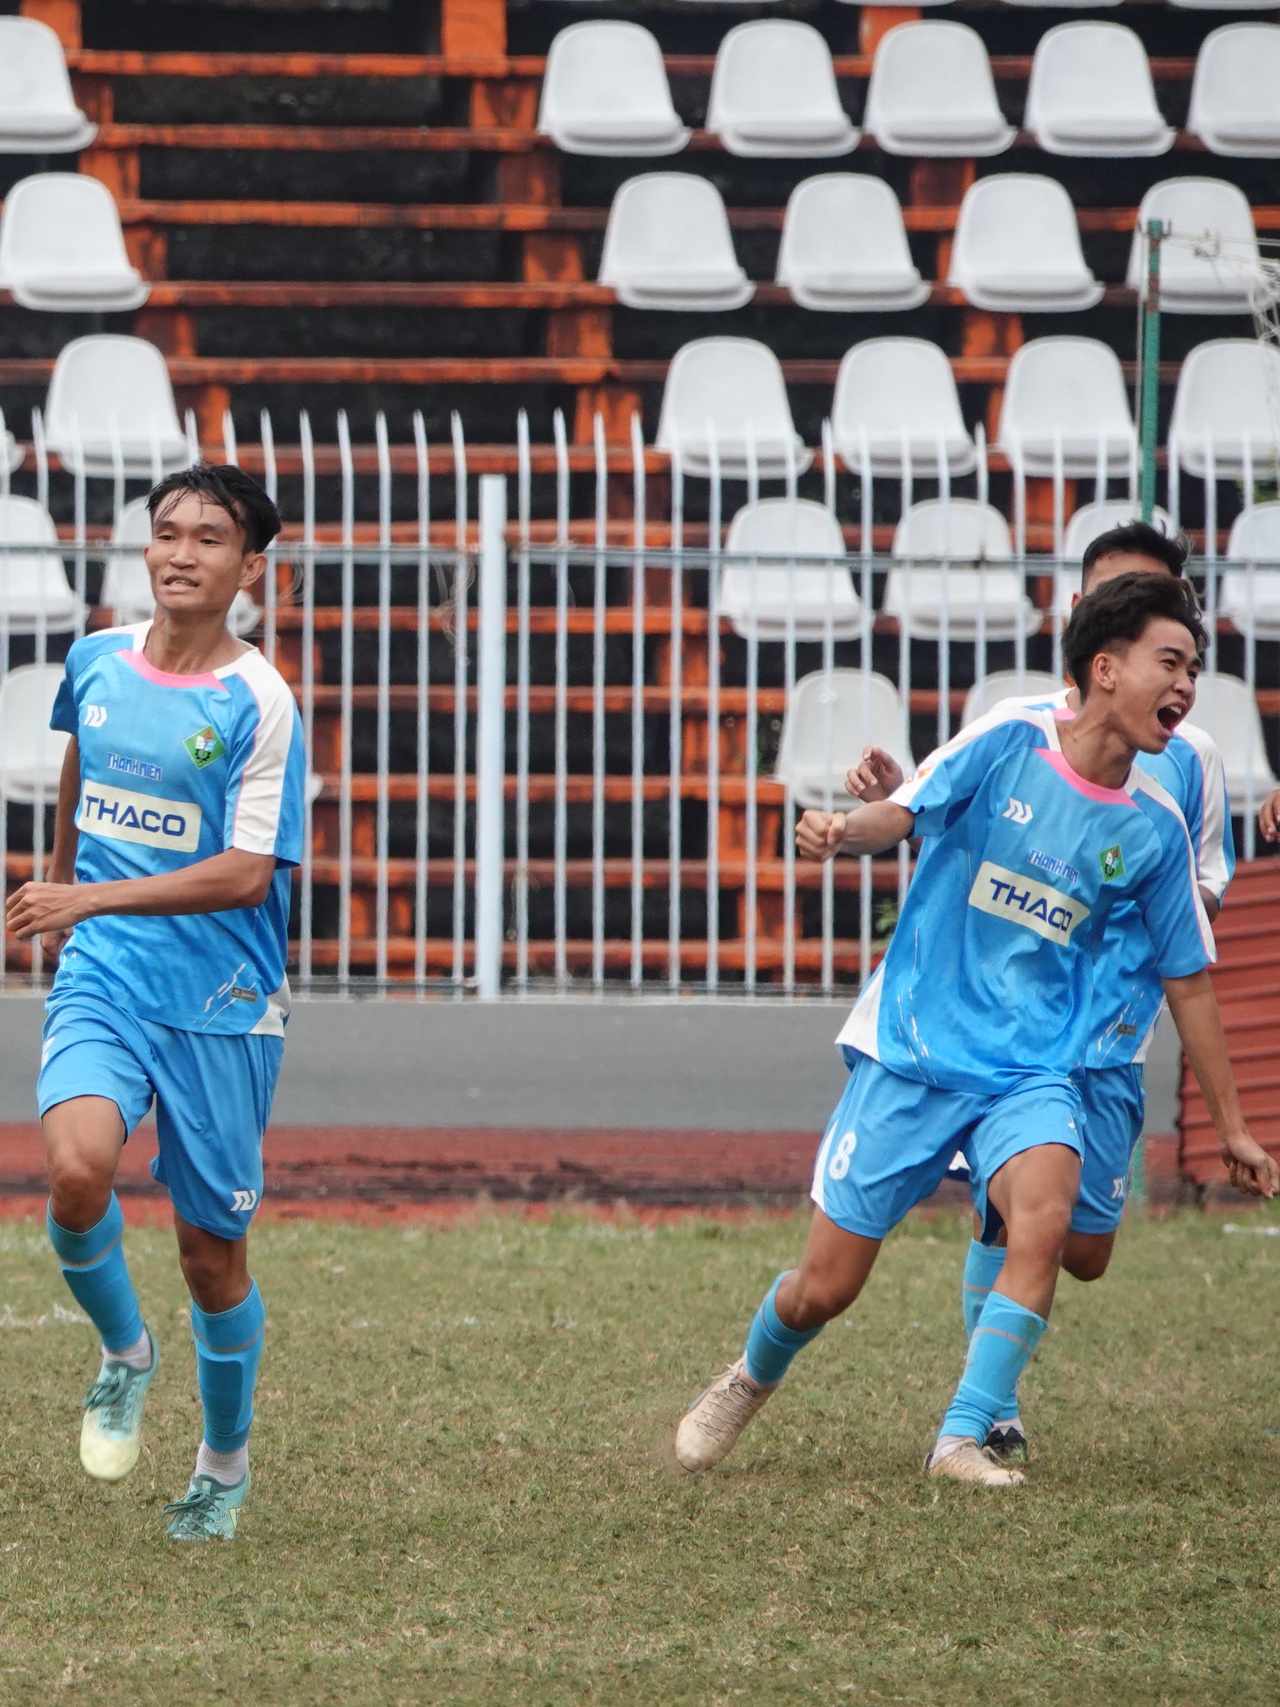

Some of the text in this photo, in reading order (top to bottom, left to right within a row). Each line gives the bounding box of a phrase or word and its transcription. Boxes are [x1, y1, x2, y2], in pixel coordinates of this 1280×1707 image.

[85, 794, 186, 837] THACO
[989, 877, 1073, 932] THACO
[828, 1131, 857, 1181] 8
